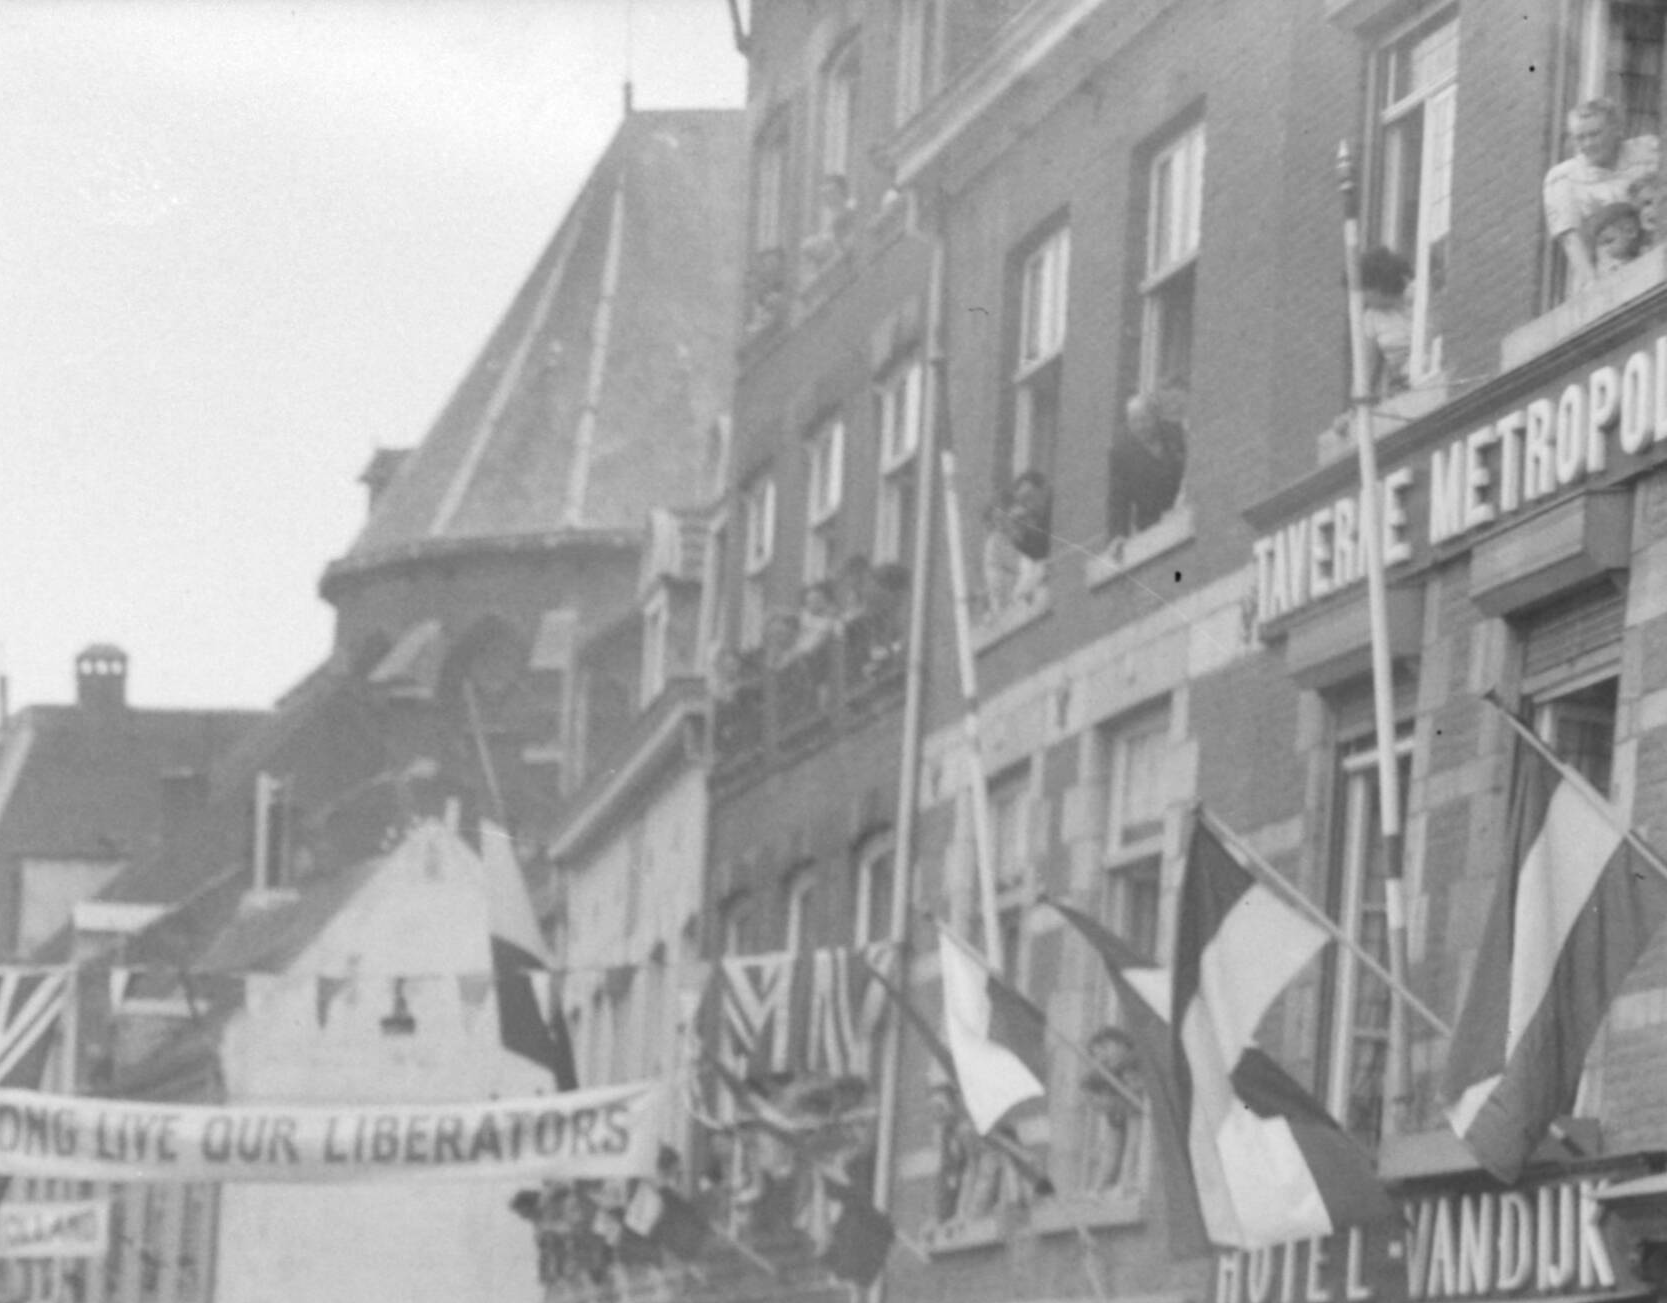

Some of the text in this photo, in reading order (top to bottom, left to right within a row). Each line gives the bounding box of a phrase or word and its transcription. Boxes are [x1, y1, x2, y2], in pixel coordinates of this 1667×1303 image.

[96, 1111, 179, 1163] LIVE
[201, 1115, 298, 1164] OUR
[323, 1104, 629, 1164] LIBERATORS
